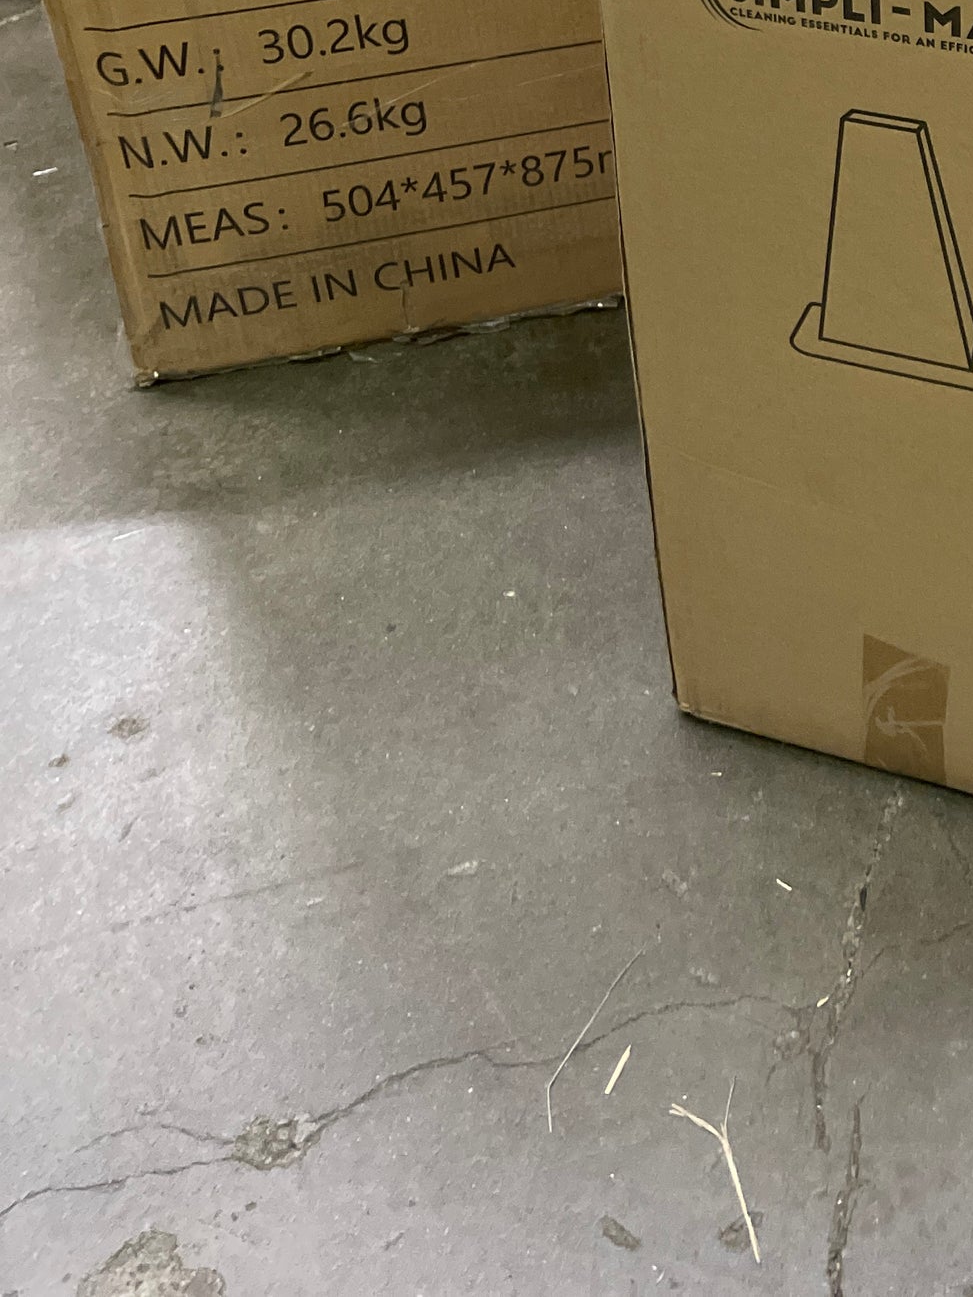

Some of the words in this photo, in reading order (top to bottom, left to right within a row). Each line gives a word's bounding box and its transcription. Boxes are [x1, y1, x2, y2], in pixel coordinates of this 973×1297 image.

[258, 14, 411, 66] 30.2kg
[729, 7, 797, 27] CLEANING
[801, 17, 878, 40] ESSENTIALS
[883, 30, 911, 46] FOR
[915, 36, 936, 49] AN
[279, 97, 428, 148] 26.6kg
[157, 281, 299, 330] MADE
[311, 268, 359, 304] IN
[373, 243, 517, 292] CHINA
